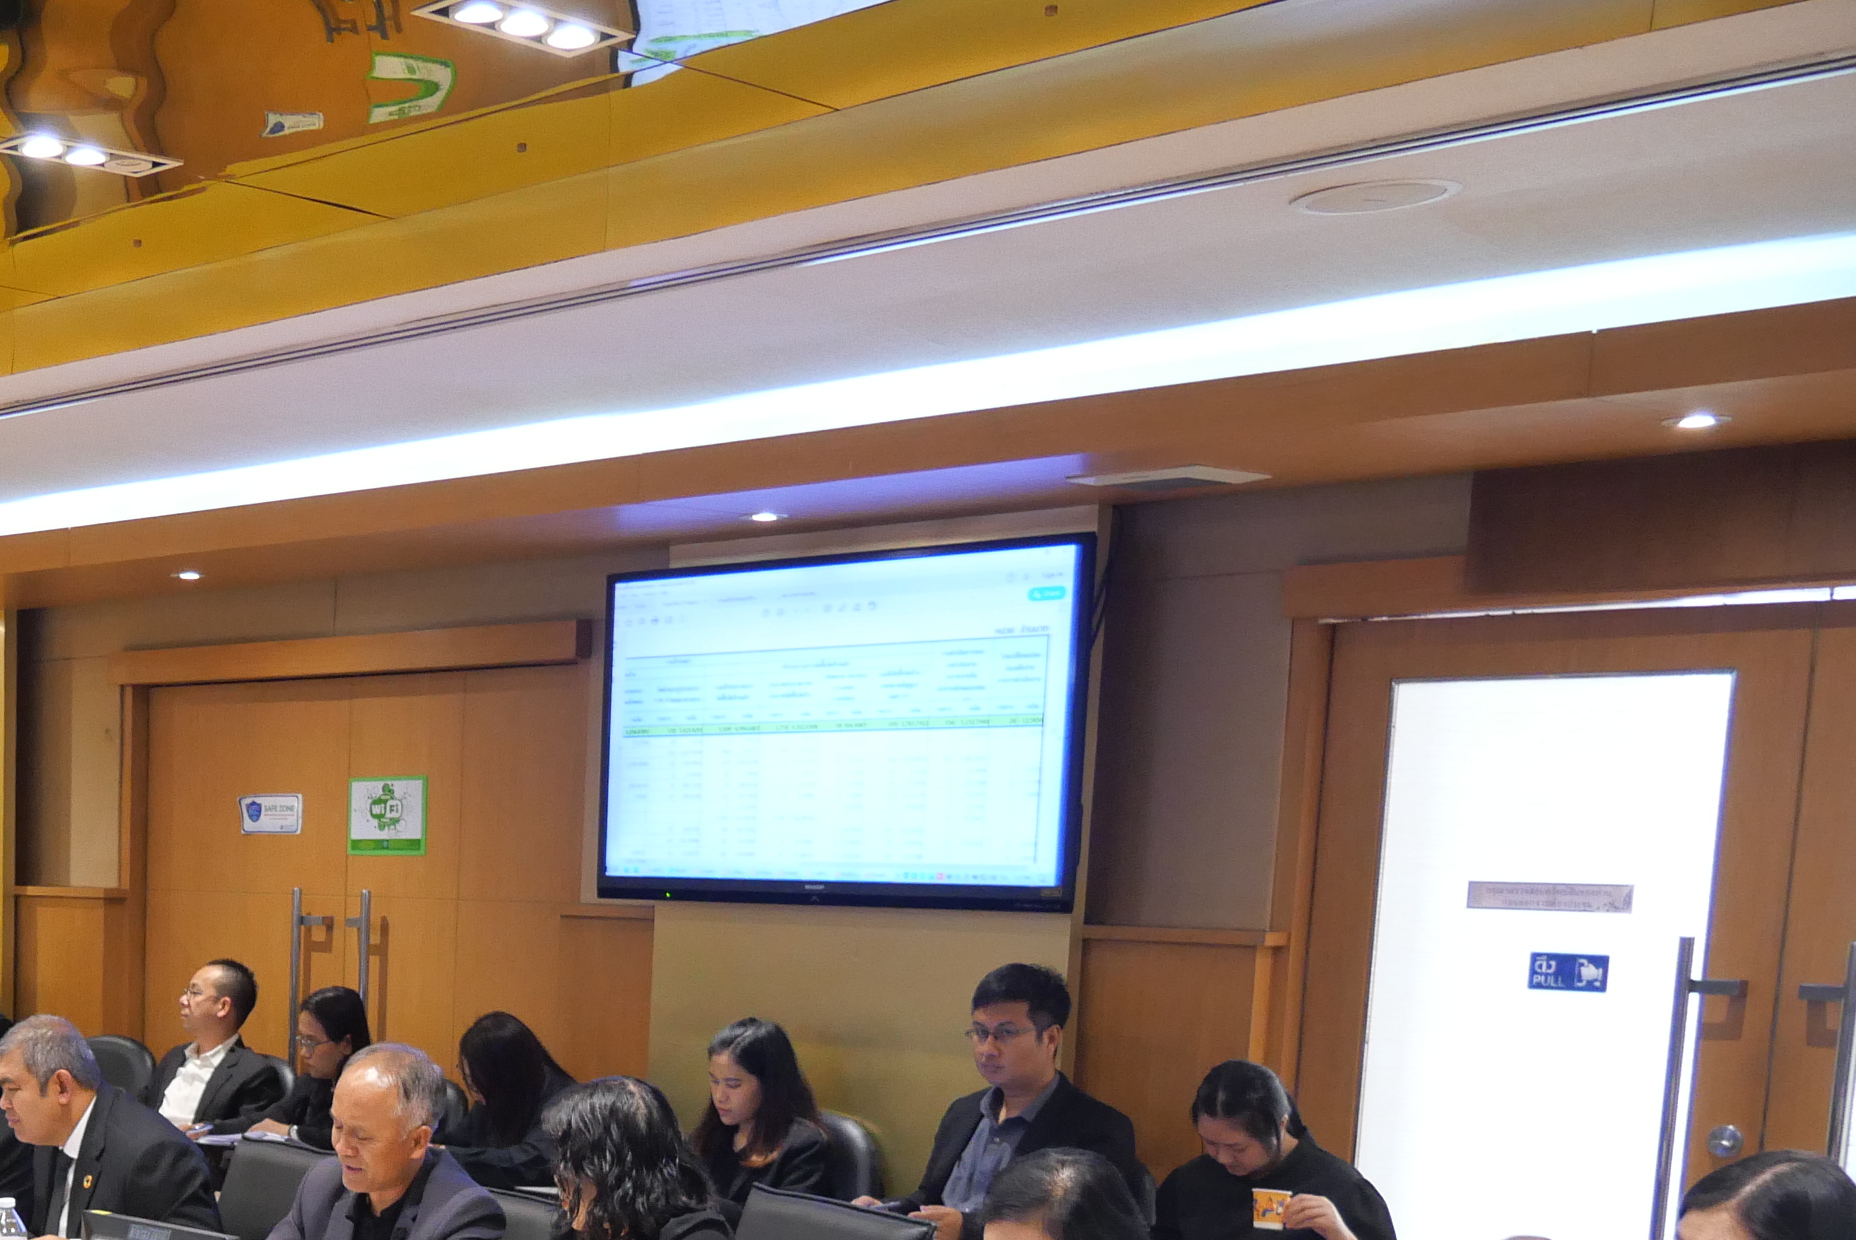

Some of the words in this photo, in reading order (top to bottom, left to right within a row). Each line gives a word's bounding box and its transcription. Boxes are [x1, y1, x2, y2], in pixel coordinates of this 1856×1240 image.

[263, 804, 278, 813] SAFE
[279, 804, 295, 813] ZONE
[1534, 956, 1557, 973] ดึง
[1533, 974, 1564, 987] PULL
